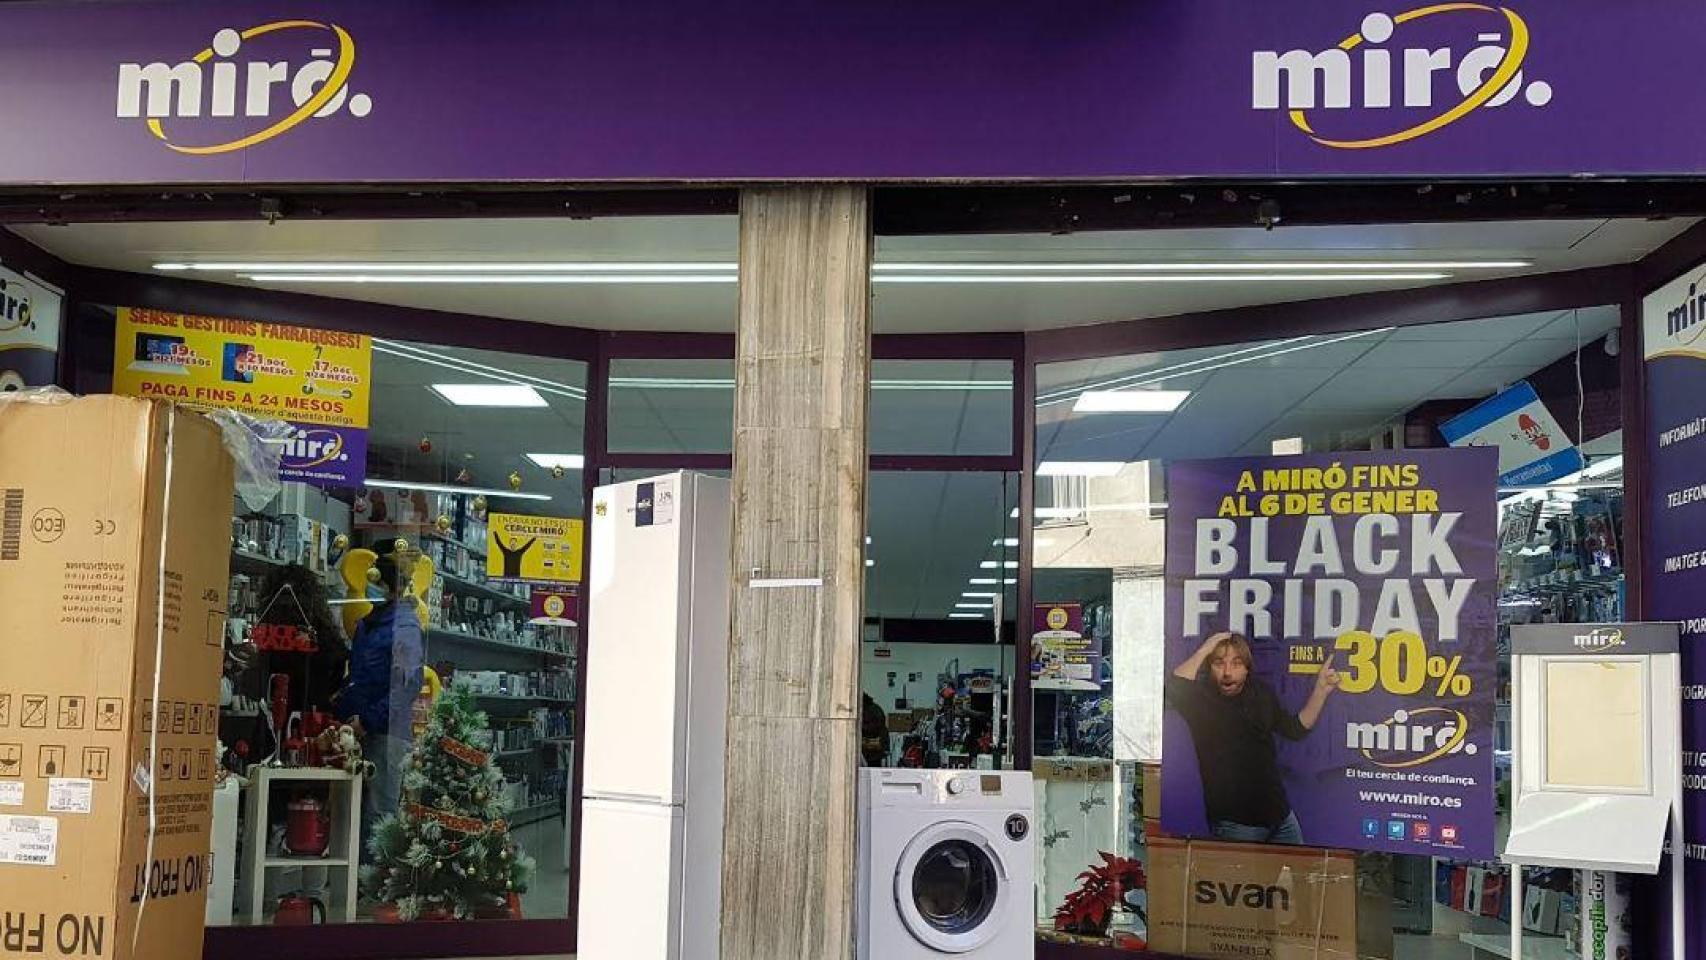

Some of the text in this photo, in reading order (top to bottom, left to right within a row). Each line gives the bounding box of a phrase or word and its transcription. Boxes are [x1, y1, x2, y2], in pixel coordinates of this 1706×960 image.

[129, 307, 178, 327] SENSE
[183, 315, 256, 336] GESTIONS
[141, 382, 189, 399] PAGA
[196, 387, 236, 404] FINS
[242, 391, 253, 405] A
[260, 394, 279, 407] 24
[285, 397, 344, 414] MESOS
[1236, 462, 1419, 493] A MIRÓ FINS
[1218, 490, 1439, 517] AL 6 DE GENER
[1194, 511, 1464, 578] BLACK
[1183, 577, 1476, 642] FRIDAY
[1289, 645, 1324, 662] FINS A
[1356, 769, 1374, 779] teu
[1375, 771, 1406, 781] cercle
[1407, 772, 1422, 782] de
[1359, 790, 1462, 807] www.miro.es
[1009, 820, 1025, 834] 10
[183, 854, 203, 894] NO
[1194, 879, 1290, 912] svan
[56, 913, 104, 956] NO
